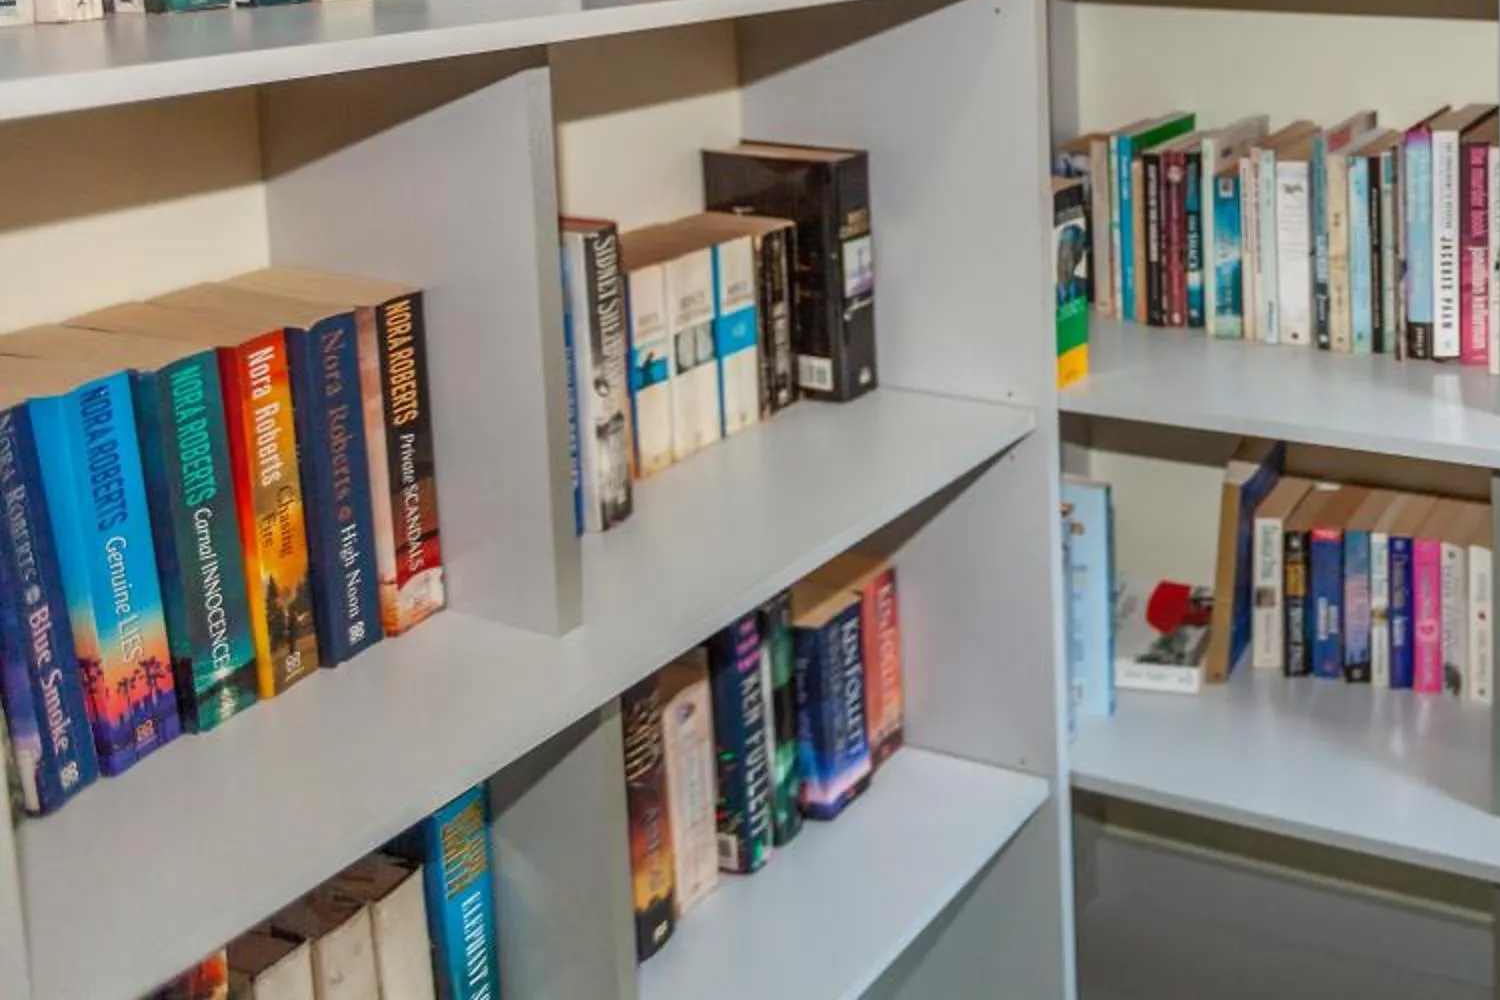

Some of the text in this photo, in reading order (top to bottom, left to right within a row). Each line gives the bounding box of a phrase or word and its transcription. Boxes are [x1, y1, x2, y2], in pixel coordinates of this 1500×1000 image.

[1471, 168, 1487, 206] murder
[1471, 209, 1487, 236] book
[592, 234, 619, 301] SIDNEY
[247, 346, 284, 486] Nora Roberts
[384, 299, 423, 572] NORA ROBERTS Private SCANDALS
[169, 365, 231, 668] NORA ROBERTS Carnal INNOCENCE
[321, 328, 363, 618] Nora Roberts High Noon
[78, 385, 144, 663] NORA ROBERTS Genuine LIES
[276, 485, 297, 558] Chasing
[29, 604, 57, 665] Blue
[40, 666, 73, 753] Smoke
[739, 675, 764, 727] KEN
[839, 617, 867, 757] KEN FOLLETT
